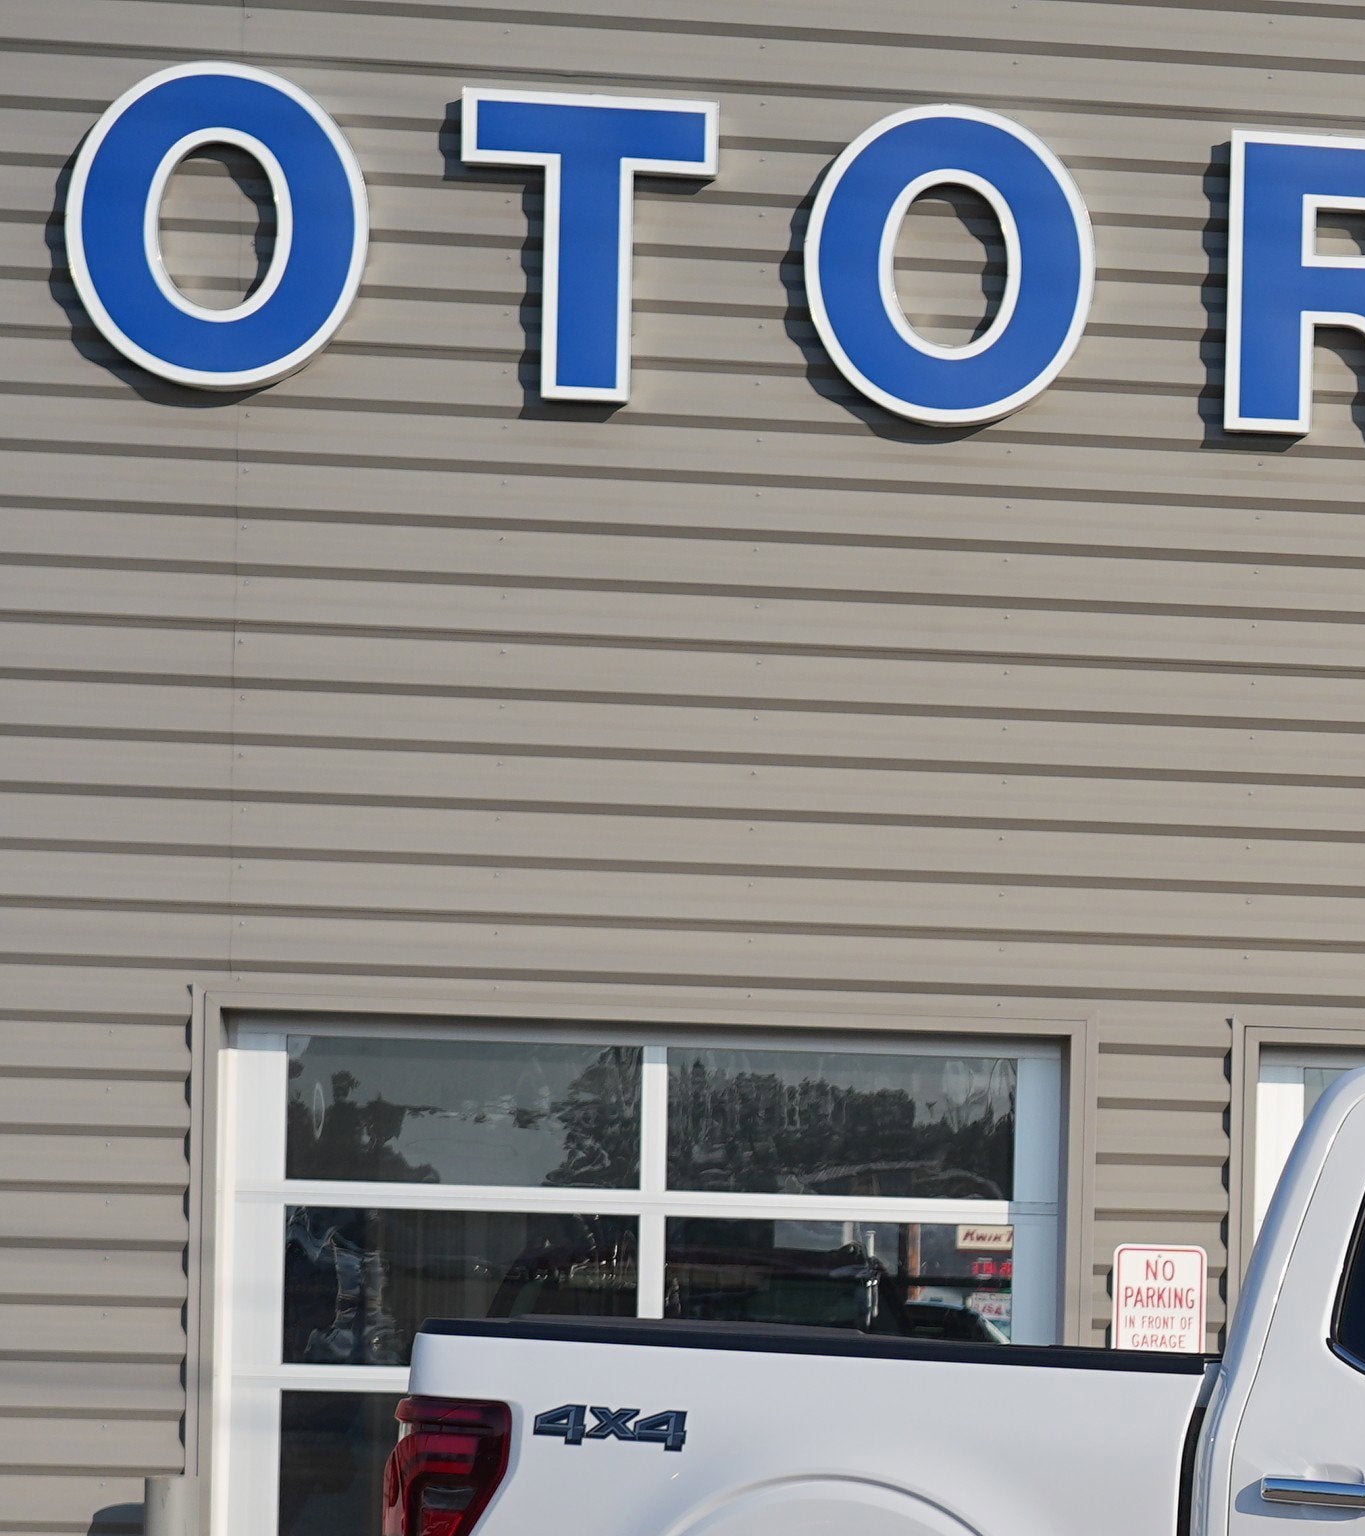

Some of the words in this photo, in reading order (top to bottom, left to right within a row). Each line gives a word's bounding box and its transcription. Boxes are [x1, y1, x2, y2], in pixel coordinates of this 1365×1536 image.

[1145, 1259, 1175, 1281] NO
[1124, 1286, 1195, 1309] PARKING
[1124, 1315, 1136, 1328] IN
[1141, 1316, 1175, 1329] FRONT
[1180, 1317, 1194, 1329] OF
[1131, 1334, 1187, 1348] GARAGE
